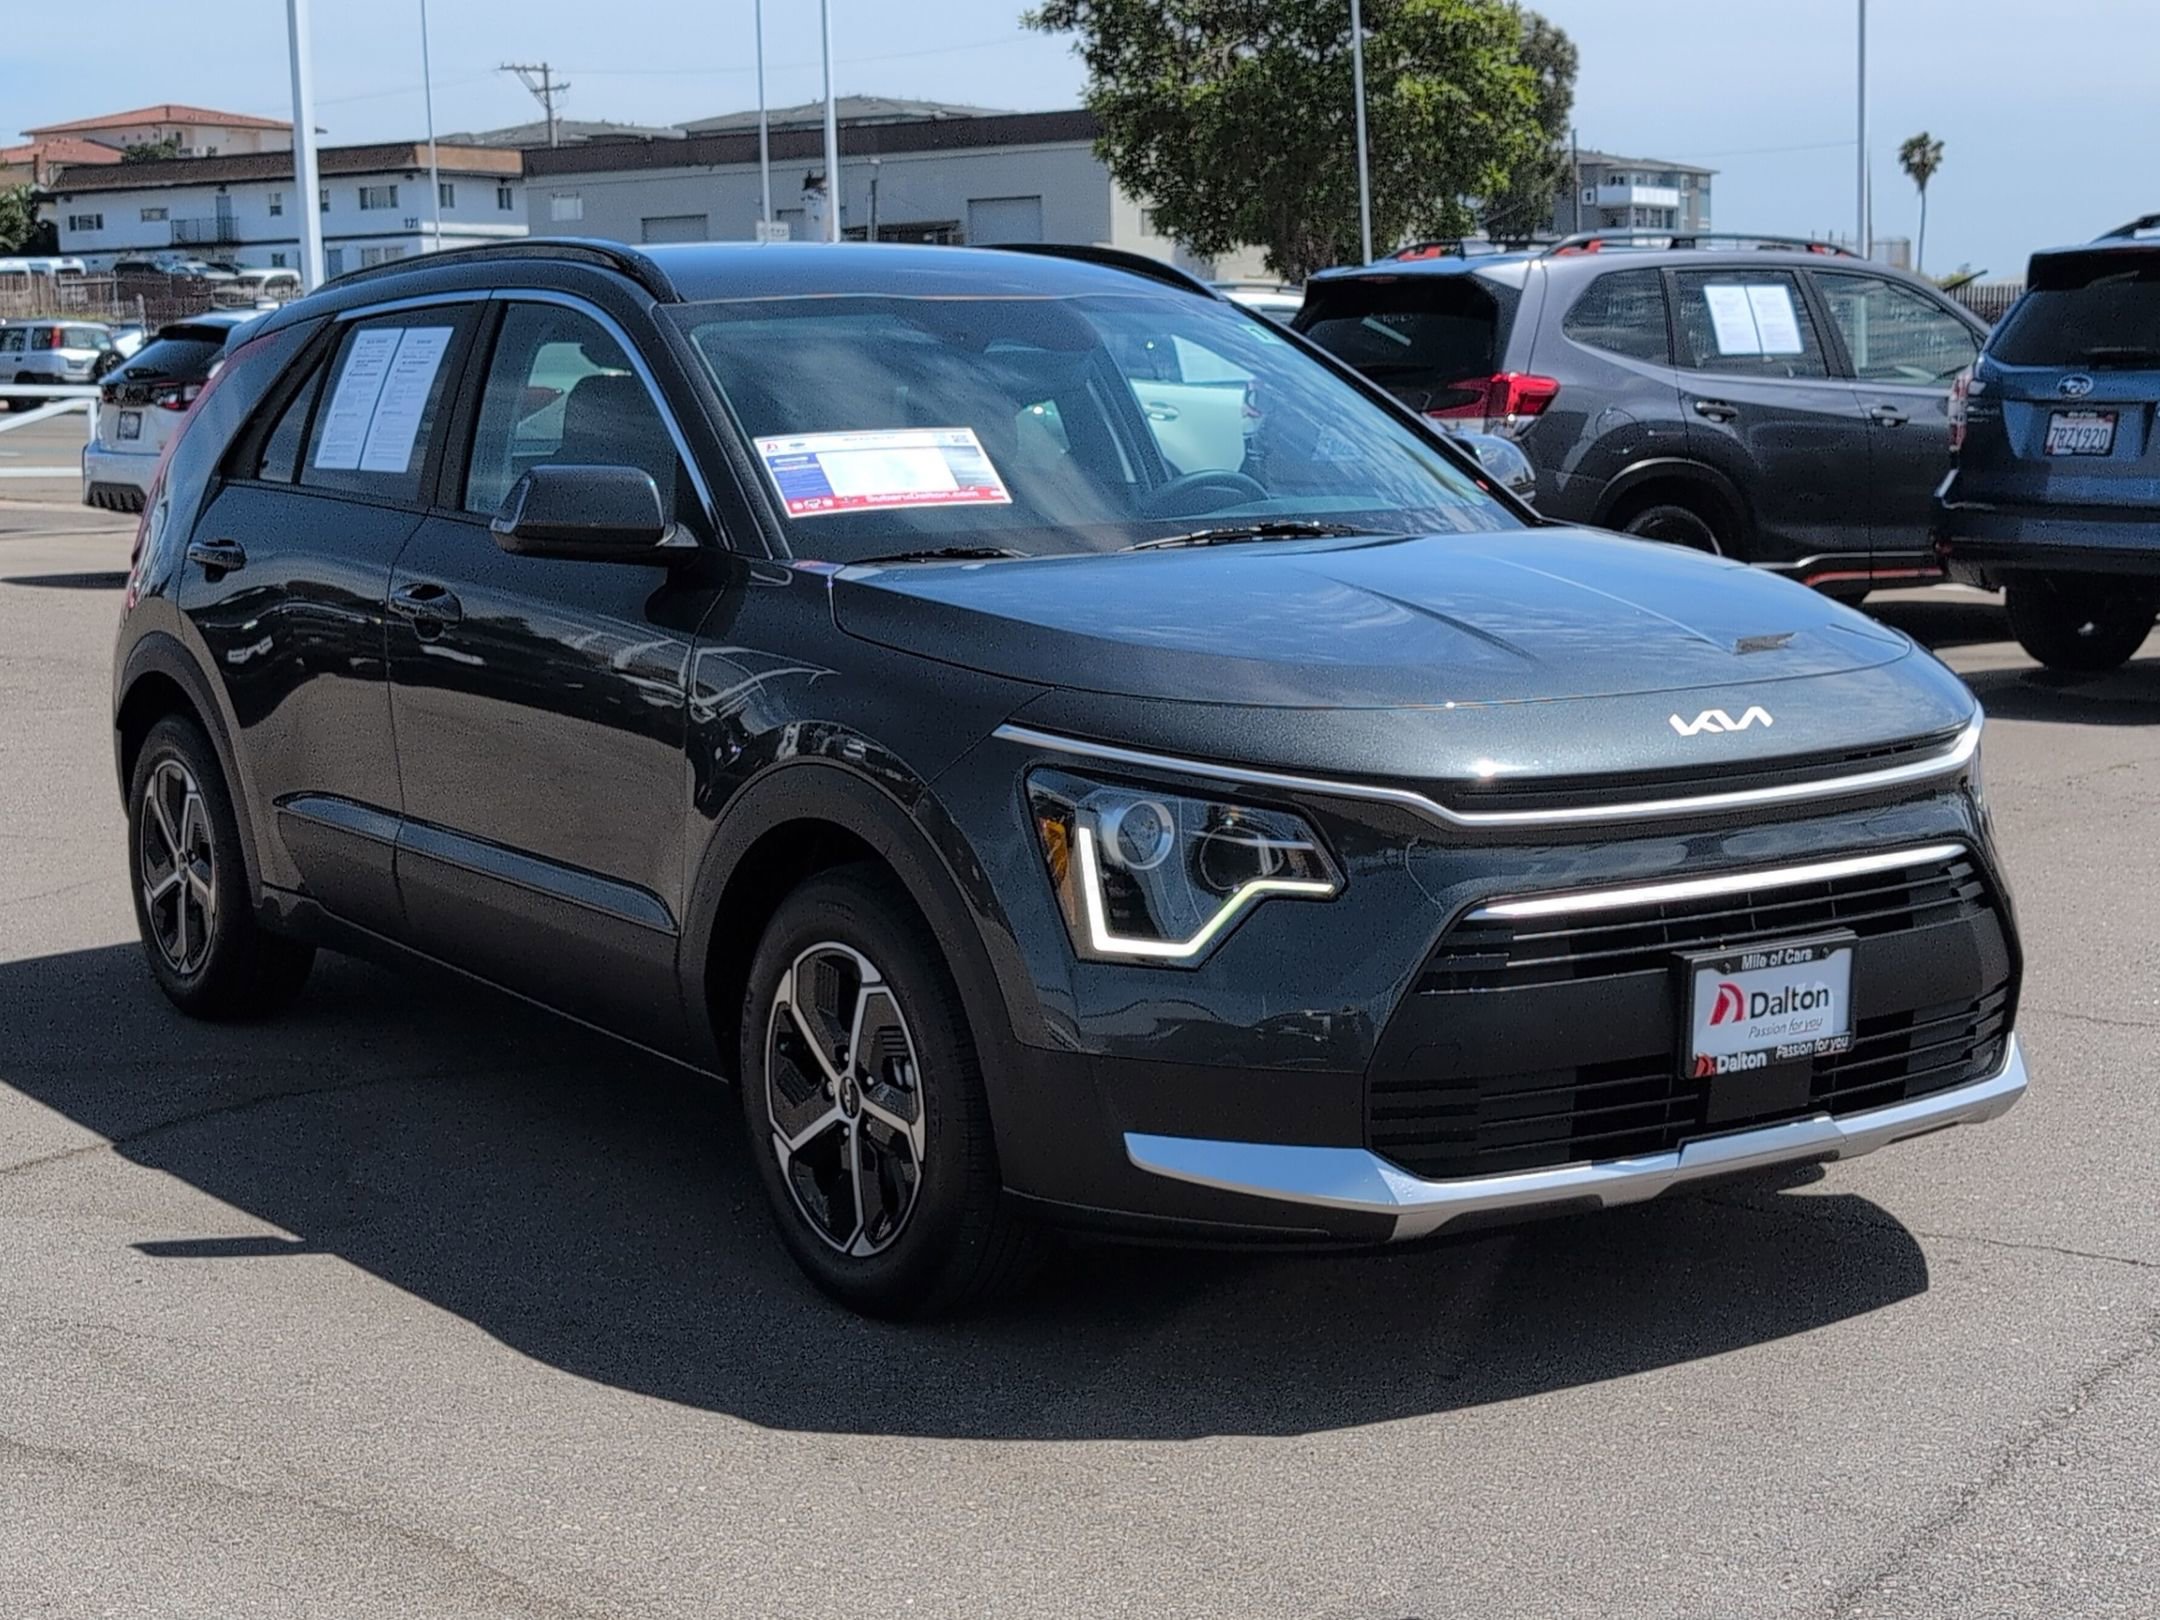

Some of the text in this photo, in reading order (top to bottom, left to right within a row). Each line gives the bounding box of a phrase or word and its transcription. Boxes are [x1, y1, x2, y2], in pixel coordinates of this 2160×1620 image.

[1669, 706, 1774, 736] KIA
[1741, 948, 1813, 970] Mile of Cars
[1750, 985, 1829, 1020] Dalton
[1748, 1016, 1824, 1039] Passion for you
[1775, 1035, 1849, 1060] Passion for you
[1716, 1051, 1767, 1075] Dalton
